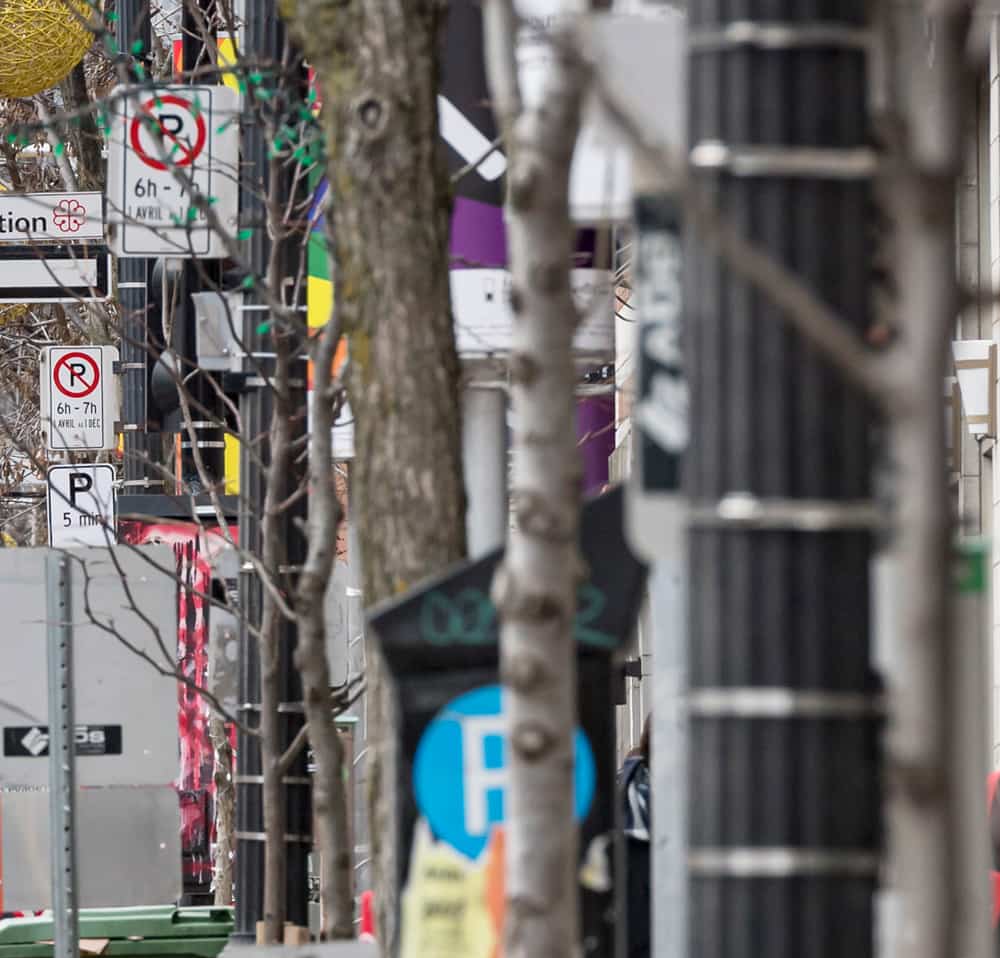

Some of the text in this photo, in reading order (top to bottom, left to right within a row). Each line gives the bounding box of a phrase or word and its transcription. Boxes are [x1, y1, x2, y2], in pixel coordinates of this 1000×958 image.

[135, 178, 157, 198] 6h
[0, 211, 47, 233] tion
[57, 402, 71, 415] 6h
[83, 402, 97, 415] 7h
[69, 472, 93, 507] P
[63, 512, 72, 528] 5
